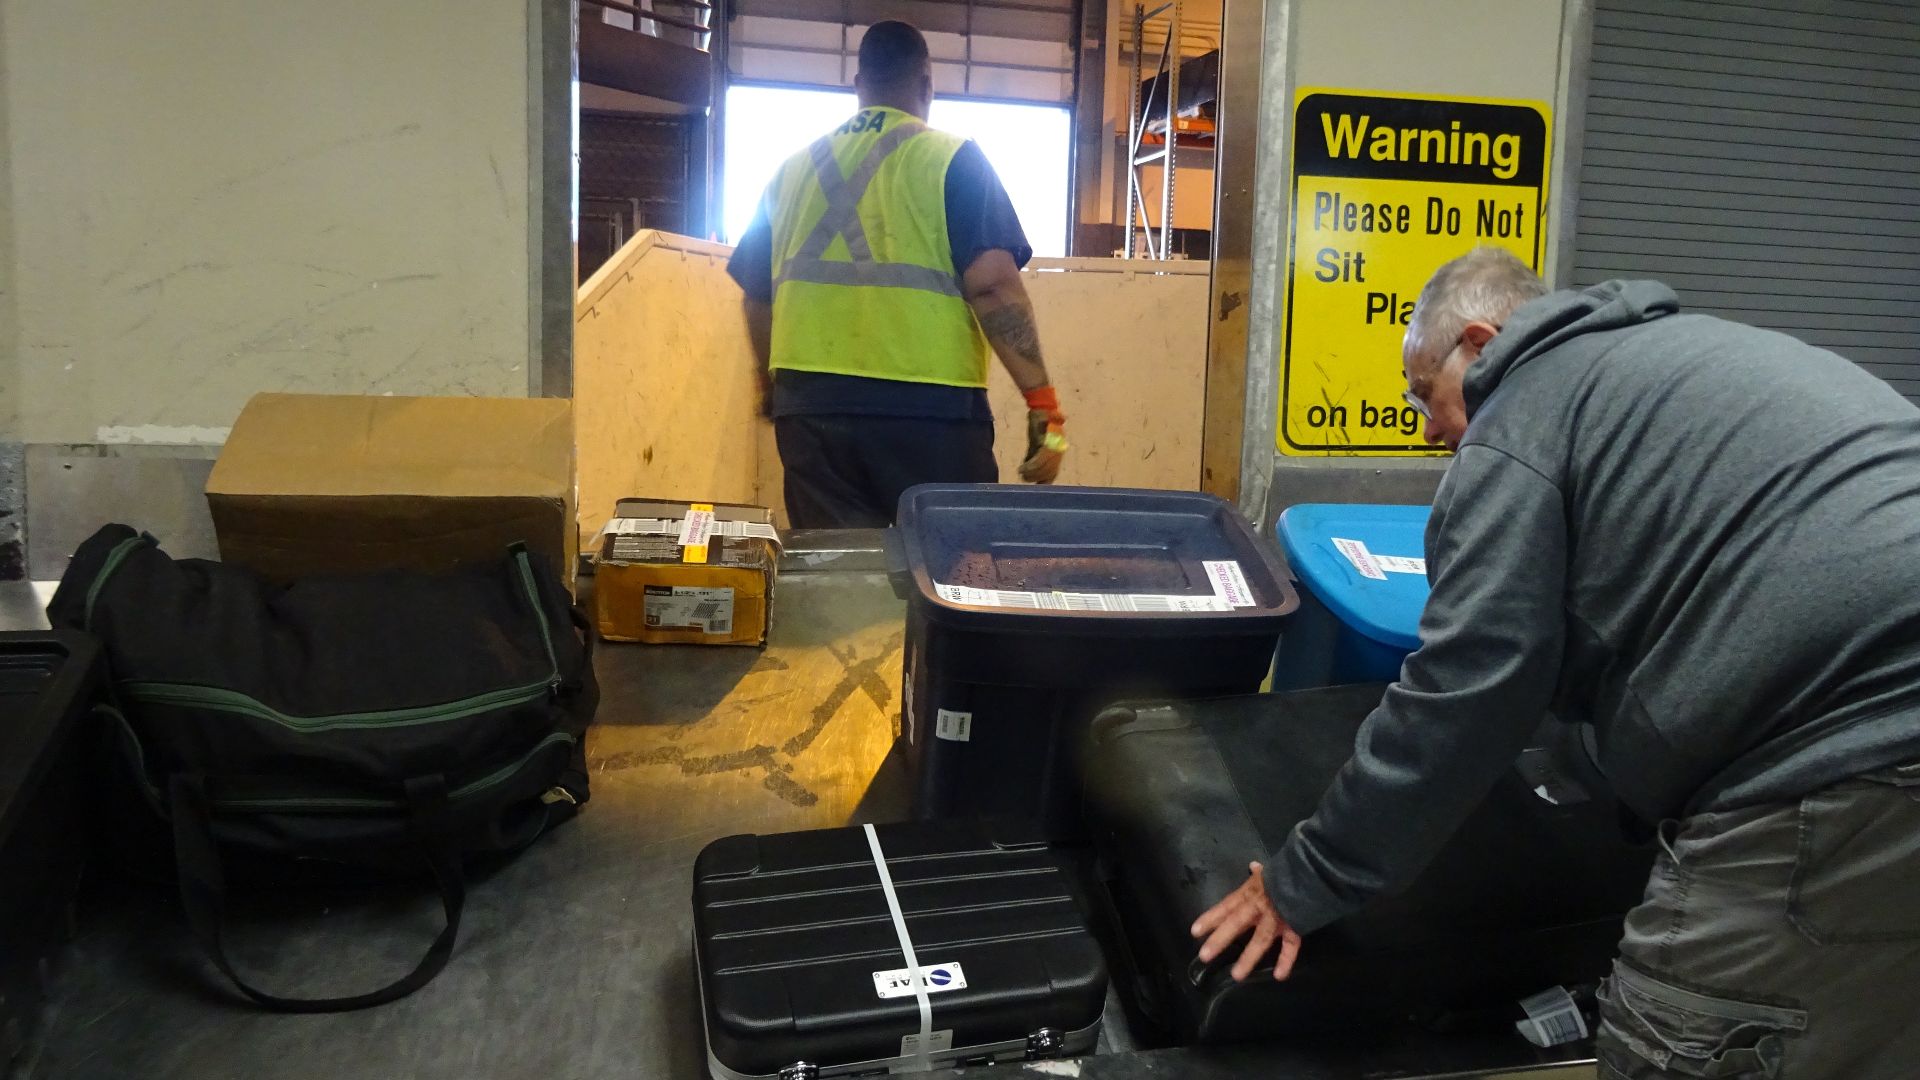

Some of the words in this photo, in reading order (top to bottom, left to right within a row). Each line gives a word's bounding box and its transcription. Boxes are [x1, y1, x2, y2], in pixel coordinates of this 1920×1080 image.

[1321, 112, 1520, 179] Warning
[1314, 191, 1410, 234] Please
[1426, 196, 1460, 236] Do
[1476, 199, 1524, 238] Not
[1314, 247, 1365, 283] Sit
[1366, 292, 1416, 326] Pla
[1307, 404, 1347, 428] on
